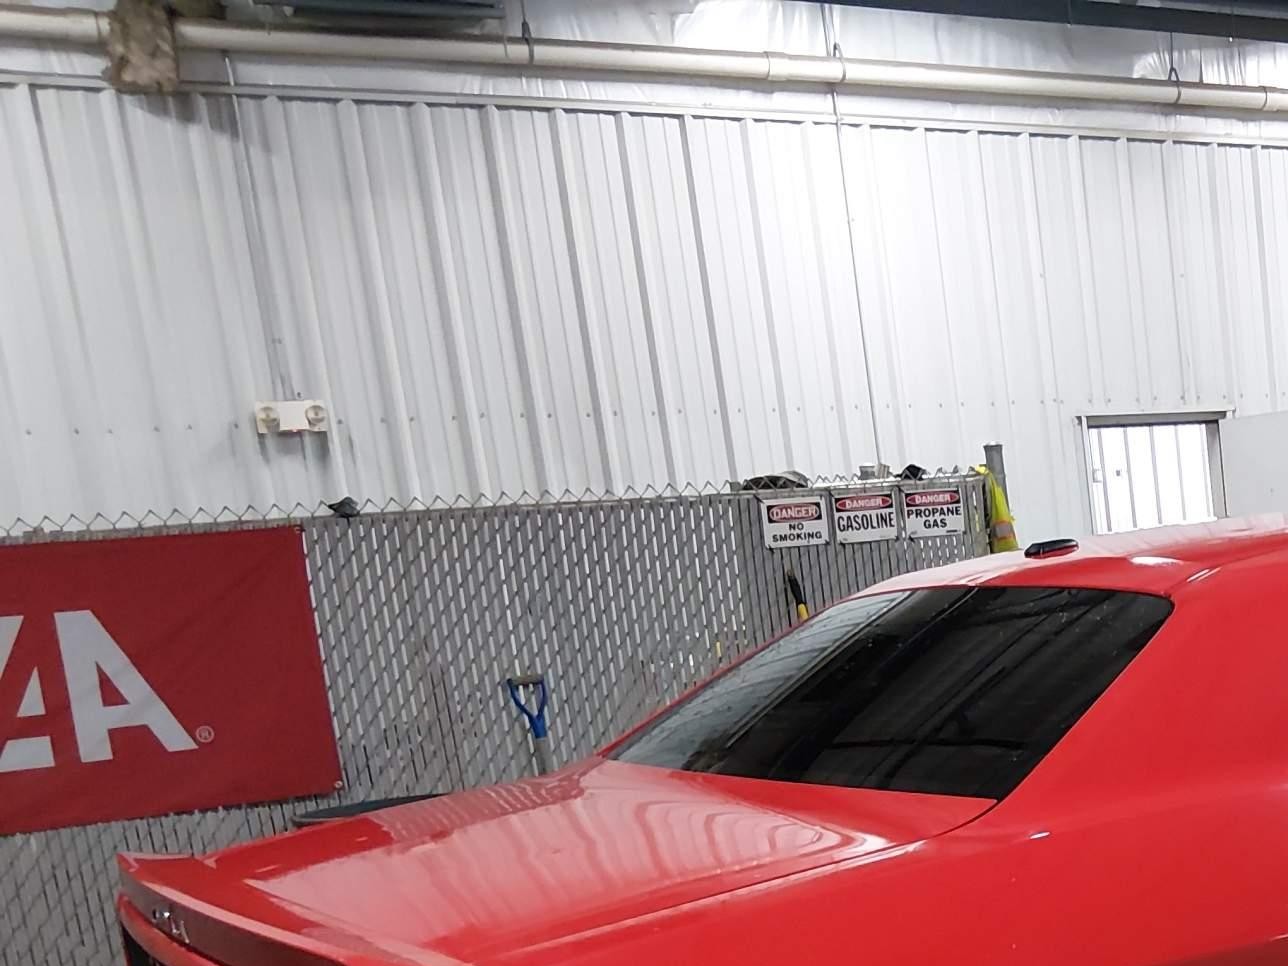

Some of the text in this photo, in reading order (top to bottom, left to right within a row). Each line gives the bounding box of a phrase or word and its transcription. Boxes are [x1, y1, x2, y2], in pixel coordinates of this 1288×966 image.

[845, 498, 883, 509] DANGER
[914, 494, 950, 504] DANGER
[773, 506, 816, 519] DANGER
[907, 506, 961, 519] PROPANE
[788, 522, 804, 531] NO
[837, 512, 895, 532] GASOLINE
[923, 519, 948, 529] GAS
[772, 531, 822, 542] SMOKING
